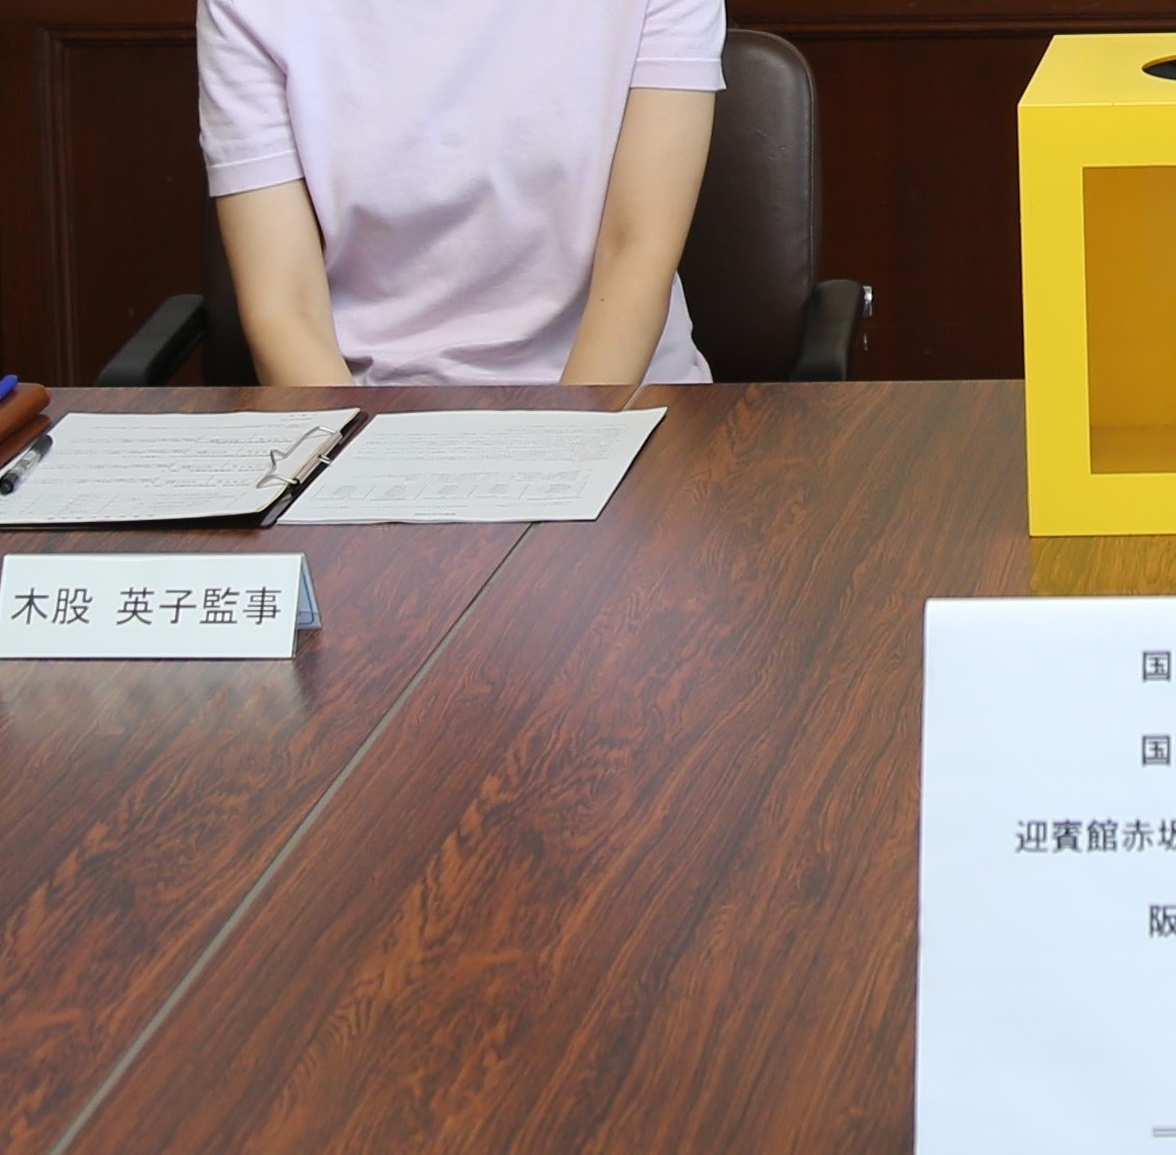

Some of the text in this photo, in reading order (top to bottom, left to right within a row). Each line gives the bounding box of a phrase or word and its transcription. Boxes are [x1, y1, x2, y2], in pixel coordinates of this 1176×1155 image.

[10, 587, 281, 625] 木股 英子監事
